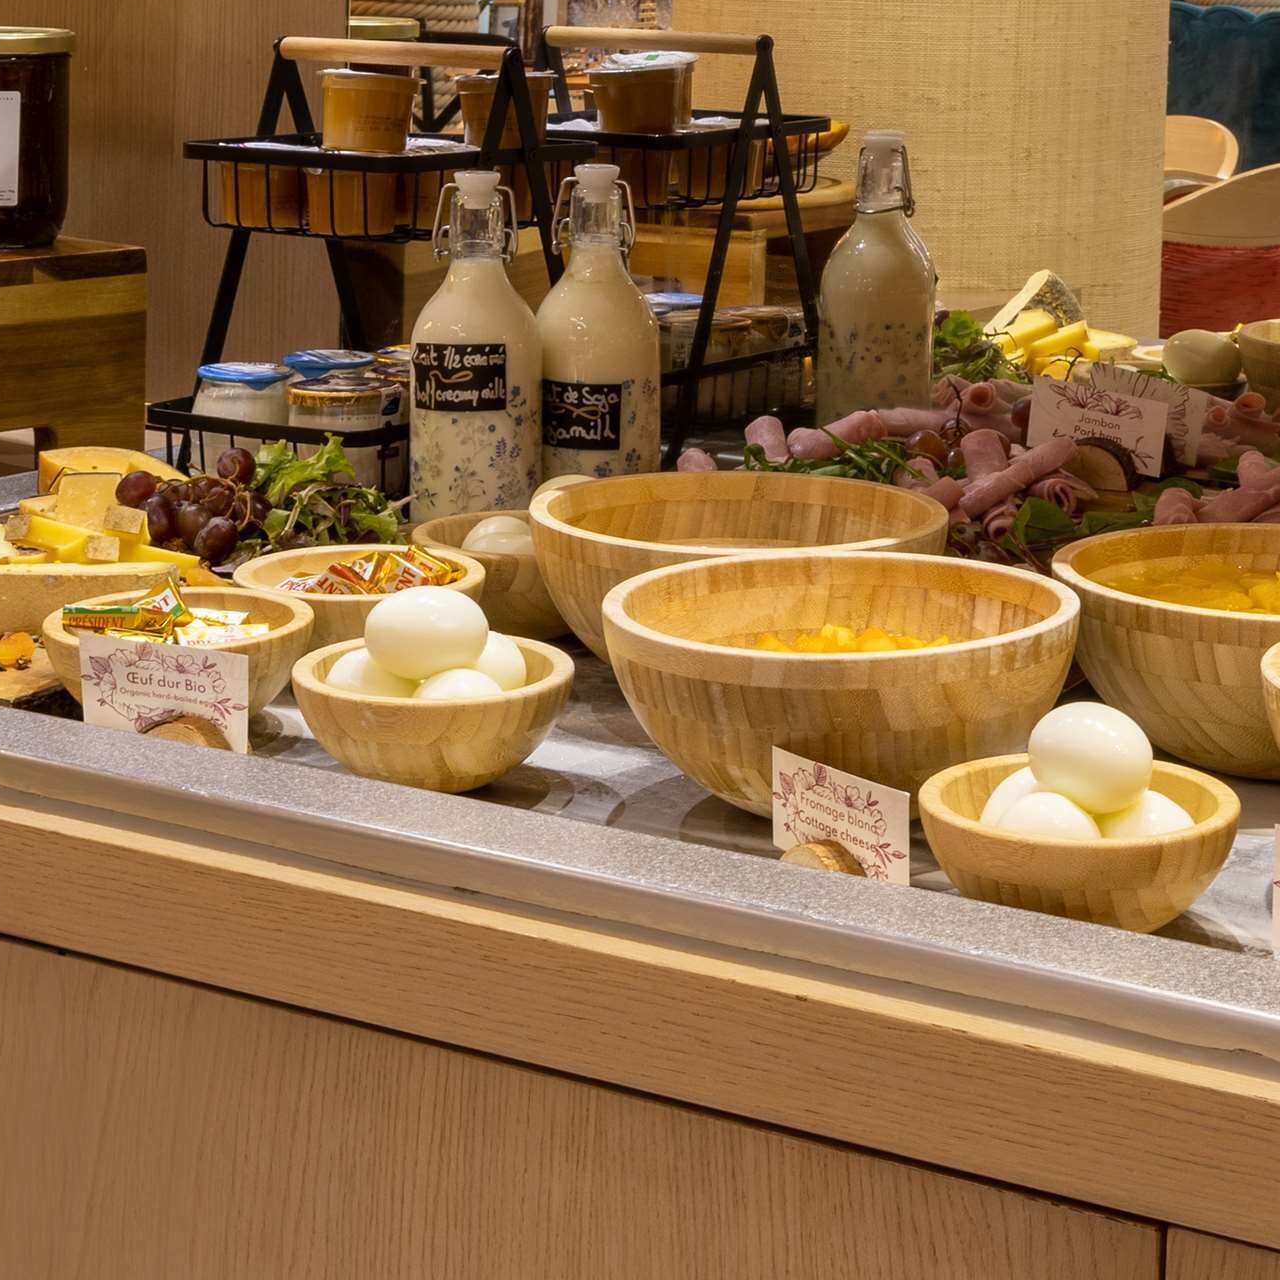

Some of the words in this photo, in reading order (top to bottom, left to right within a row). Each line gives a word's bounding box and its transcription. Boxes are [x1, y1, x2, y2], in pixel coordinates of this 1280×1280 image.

[442, 346, 462, 370] 1/2
[563, 386, 579, 404] de
[1074, 425, 1097, 436] Pork
[1079, 413, 1121, 430] Jambon
[126, 671, 153, 686] Œuf
[157, 675, 180, 689] dur
[185, 679, 206, 693] Bio
[800, 791, 845, 822] Fromage
[847, 813, 878, 834] blanc
[798, 809, 838, 838] Cottage
[840, 828, 877, 853] cheese
